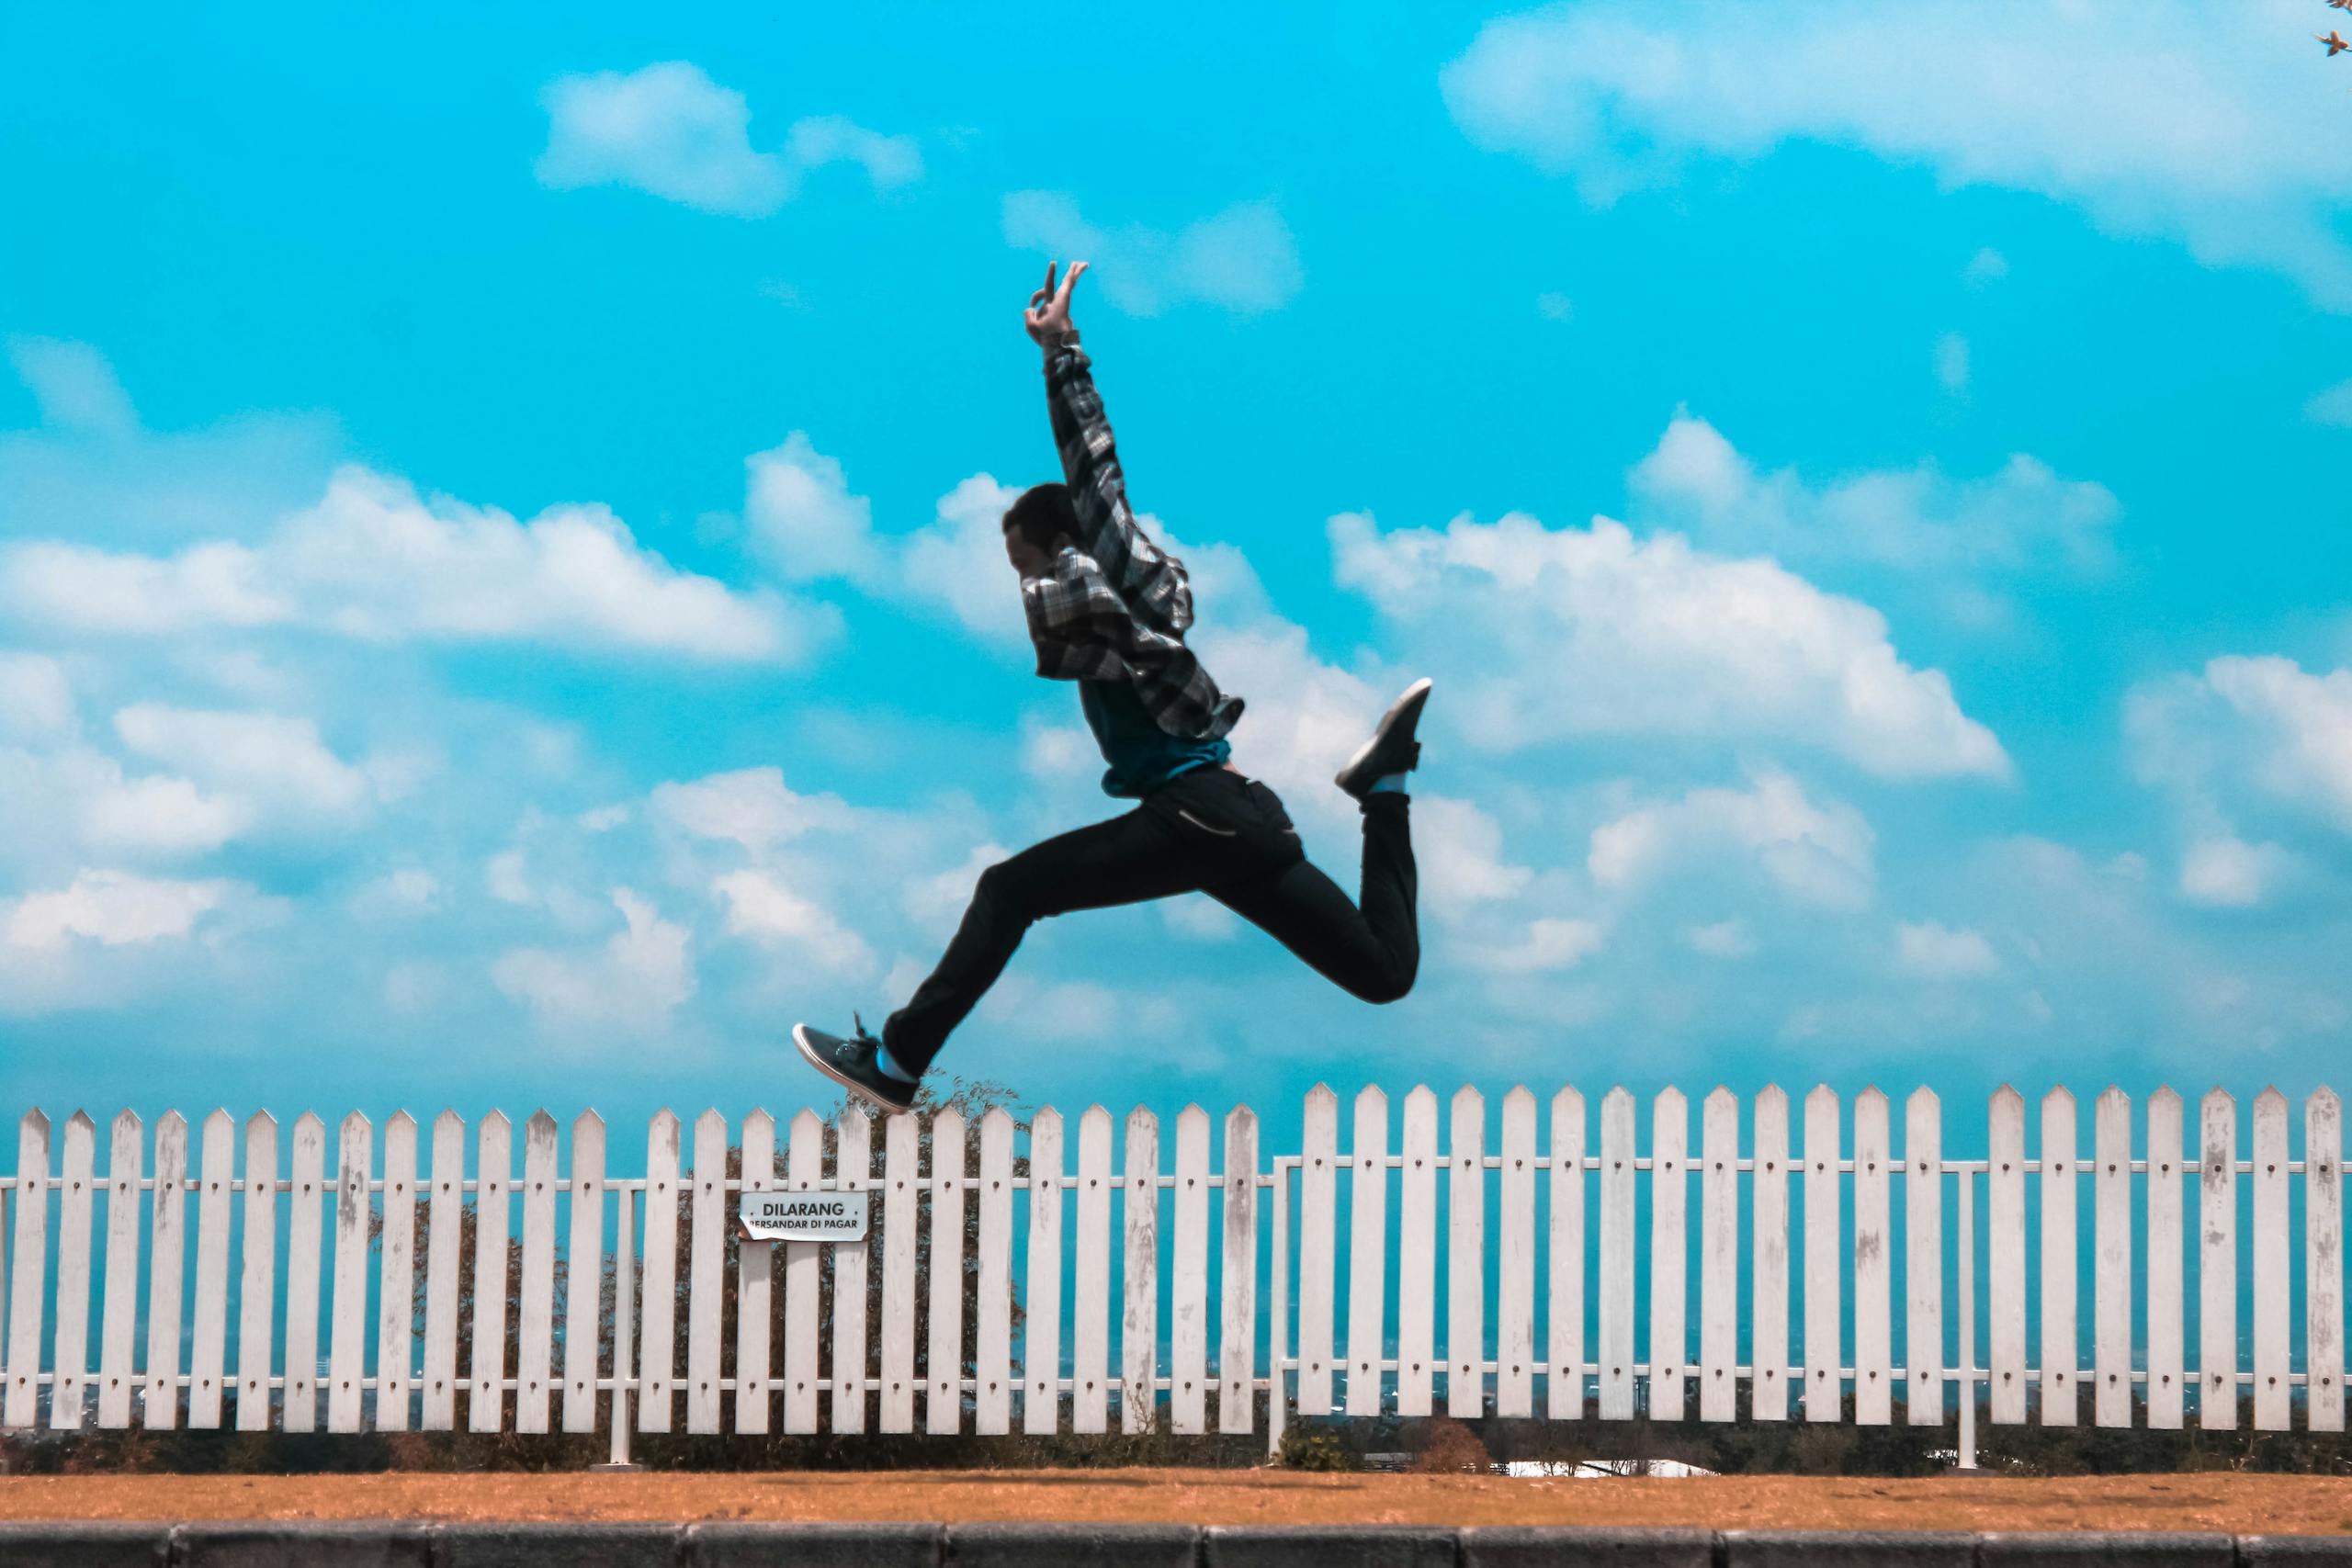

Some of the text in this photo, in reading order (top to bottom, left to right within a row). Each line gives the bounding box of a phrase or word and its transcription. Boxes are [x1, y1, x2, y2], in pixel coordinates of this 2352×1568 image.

[763, 1203, 844, 1216] DILARANG
[810, 1220, 820, 1228] DI
[824, 1220, 857, 1228] PAGAR
